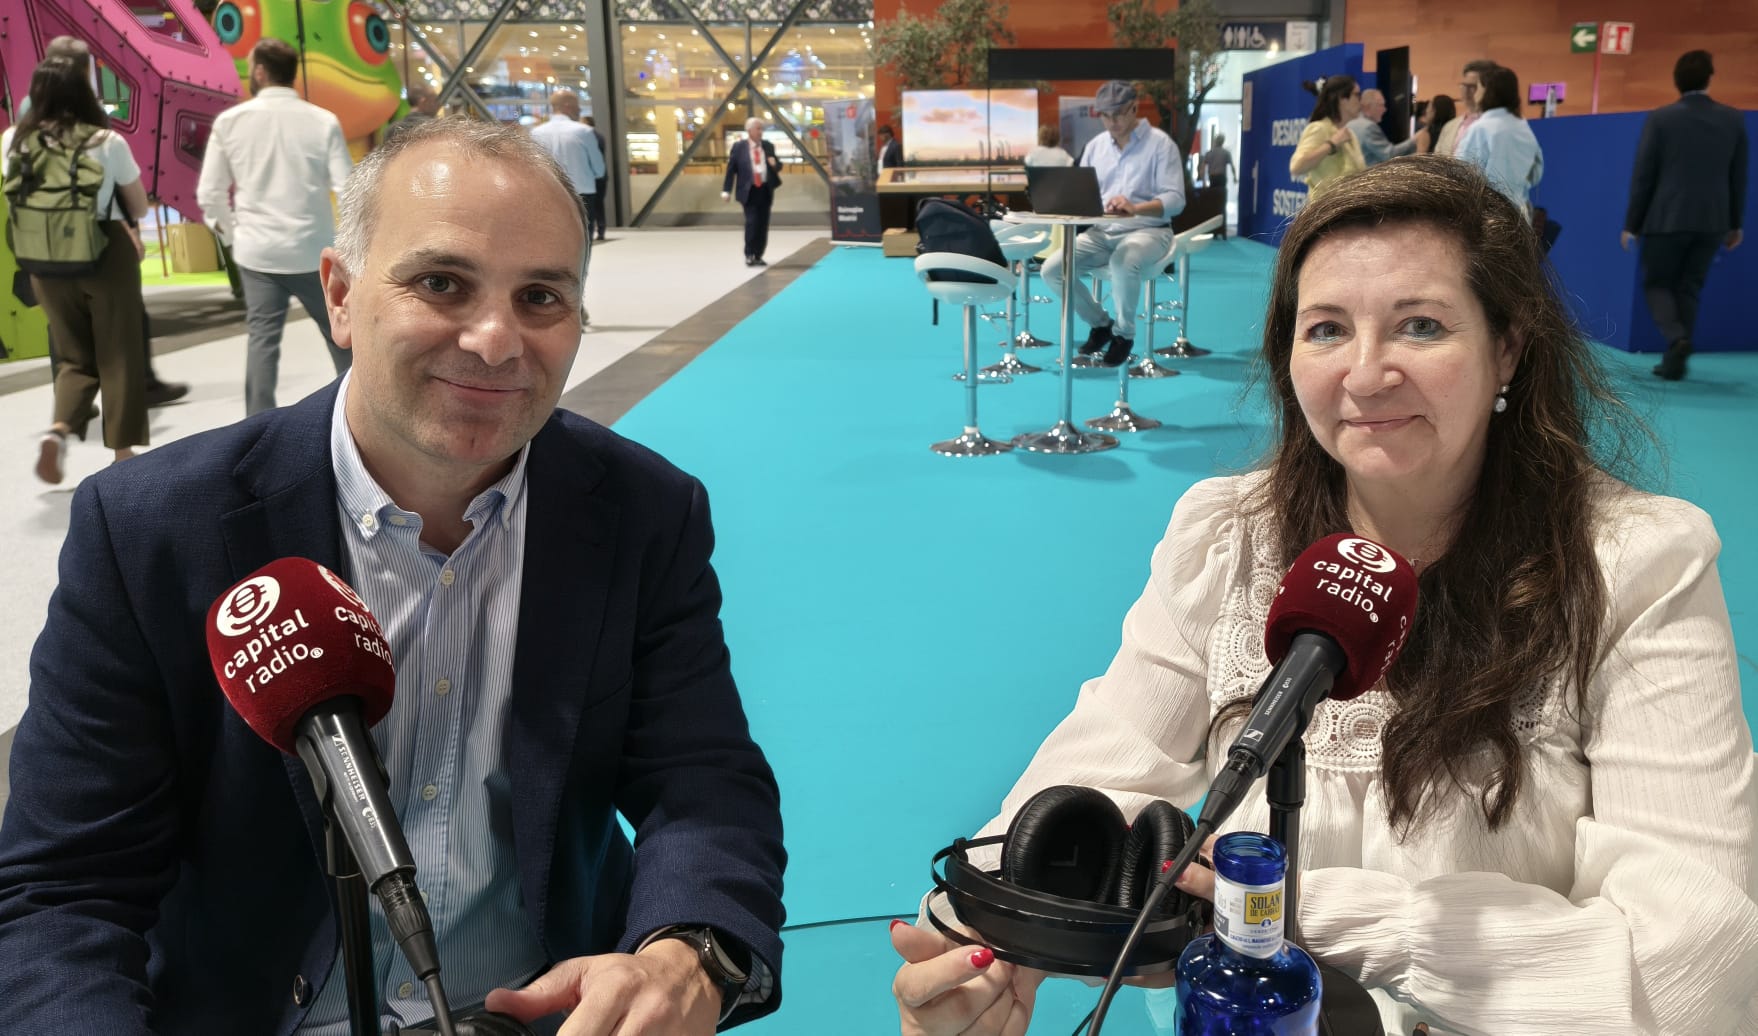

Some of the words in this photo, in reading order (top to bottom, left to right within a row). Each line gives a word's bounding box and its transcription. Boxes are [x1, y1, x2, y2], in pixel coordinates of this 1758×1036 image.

[1313, 560, 1393, 603] capital
[223, 608, 309, 680] capital
[338, 746, 366, 801] SENNHEISER
[1250, 892, 1281, 909] SOLAN
[1250, 909, 1259, 917] DE
